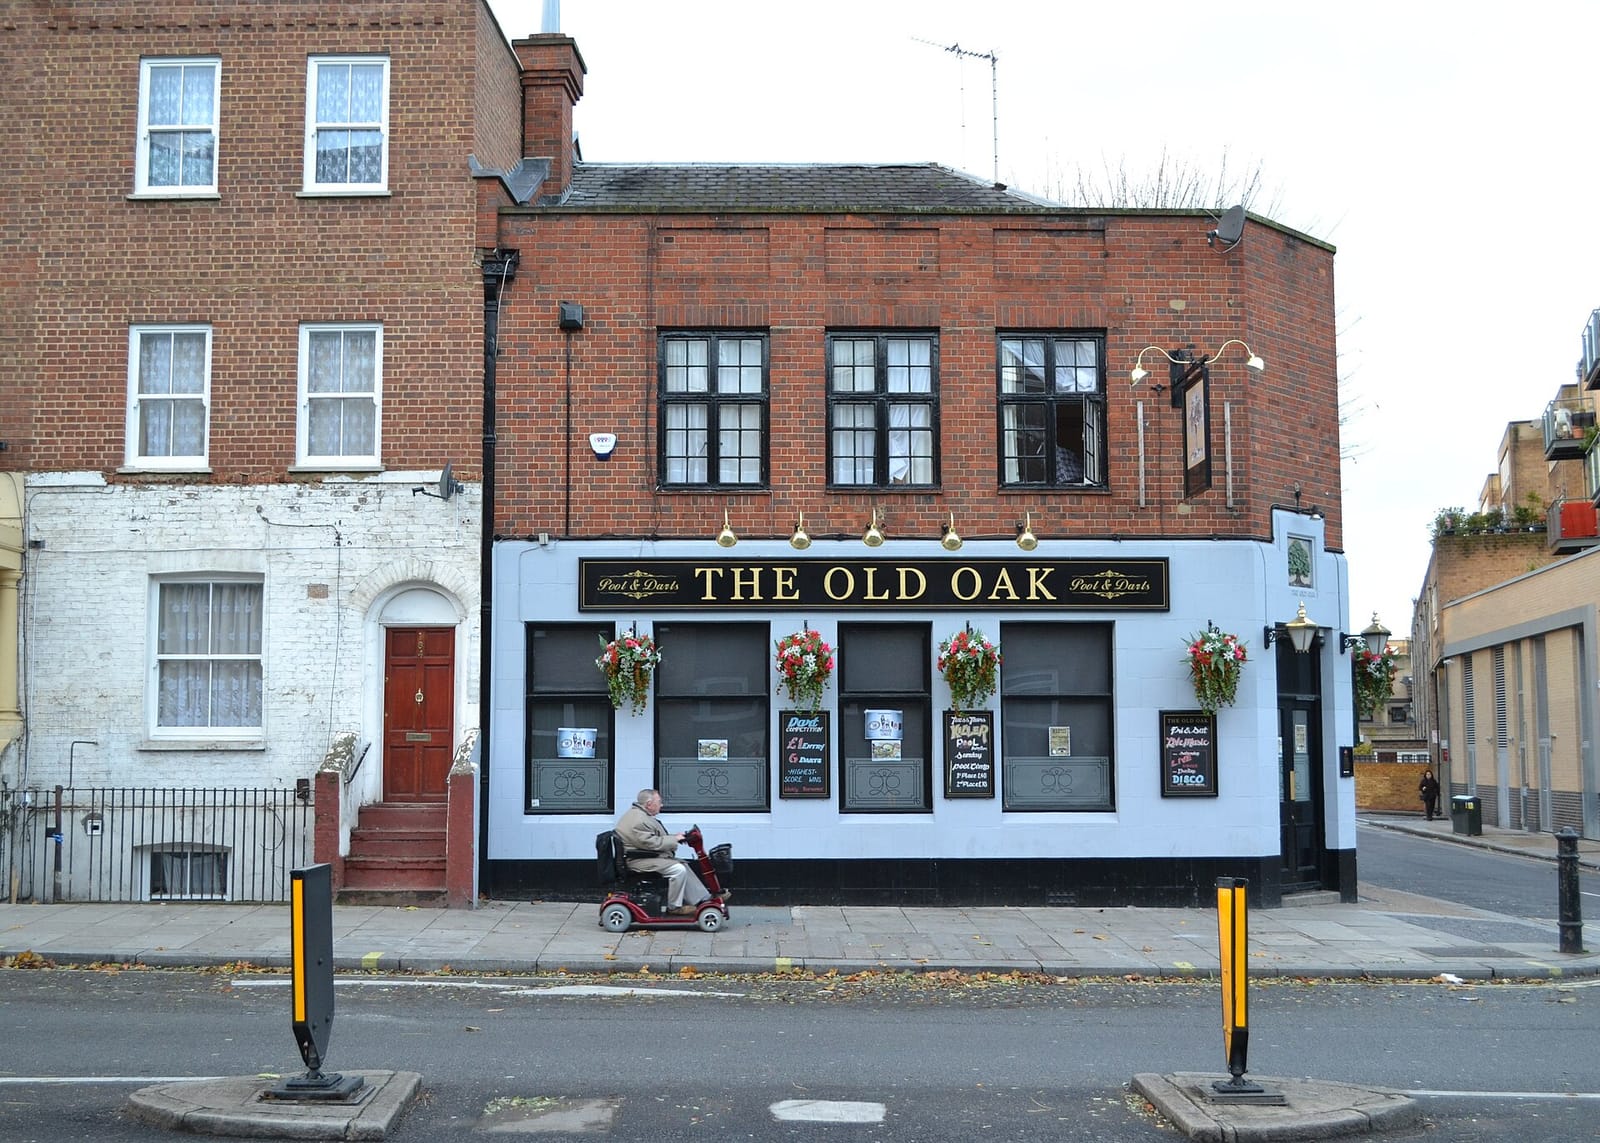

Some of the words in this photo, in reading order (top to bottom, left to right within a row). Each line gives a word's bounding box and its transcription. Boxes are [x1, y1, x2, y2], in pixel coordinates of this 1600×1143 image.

[597, 578, 627, 591] Pool
[630, 578, 640, 591] &
[642, 578, 679, 591] Darts
[694, 567, 799, 600] THE
[824, 566, 927, 600] OLD
[951, 566, 1057, 600] OAK
[1069, 578, 1099, 591] Pool
[1101, 578, 1112, 591] &
[1114, 578, 1150, 591] Darts
[1172, 774, 1205, 784] DISCO
